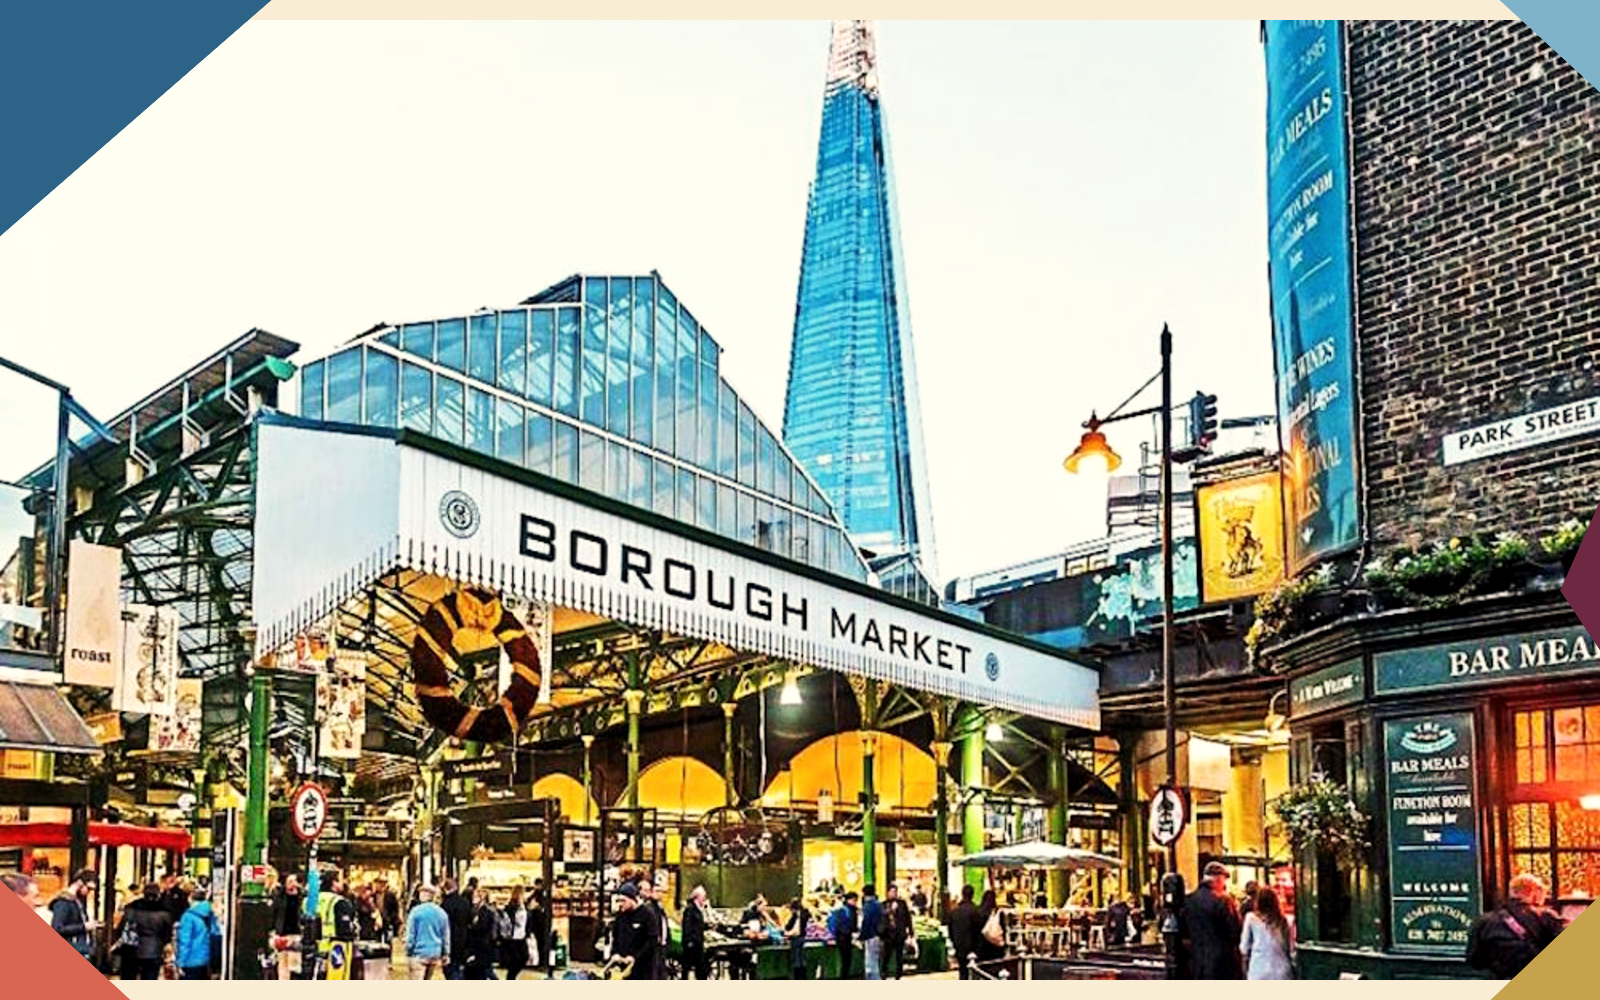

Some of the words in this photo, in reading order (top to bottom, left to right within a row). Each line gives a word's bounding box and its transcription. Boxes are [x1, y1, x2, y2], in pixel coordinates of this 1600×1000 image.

[1285, 88, 1332, 150] MEALS
[1459, 422, 1513, 450] PARK
[1524, 401, 1598, 434] STREET
[518, 512, 810, 631] BOROUGH
[830, 606, 973, 675] MARKET
[71, 647, 112, 663] roast
[1448, 646, 1512, 677] BAR
[1391, 759, 1419, 774] BAR
[1421, 755, 1470, 771] MEALS
[1393, 795, 1441, 810] FUNCTION
[1442, 793, 1471, 808] ROOM
[1402, 882, 1469, 893] WELCOME
